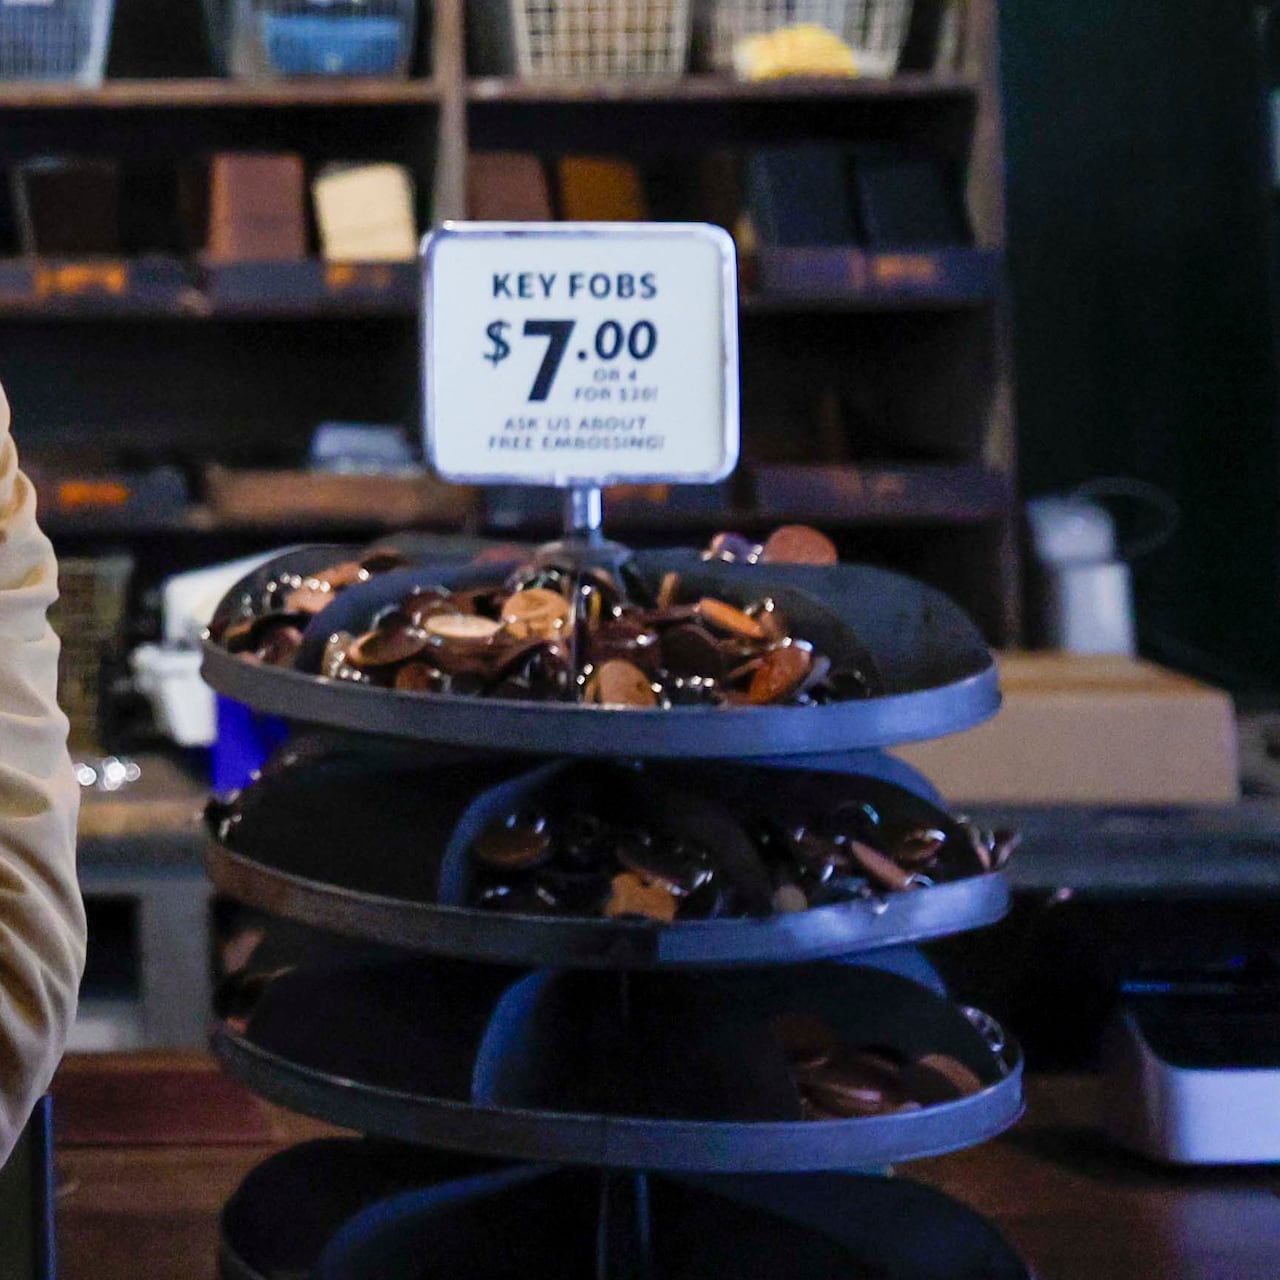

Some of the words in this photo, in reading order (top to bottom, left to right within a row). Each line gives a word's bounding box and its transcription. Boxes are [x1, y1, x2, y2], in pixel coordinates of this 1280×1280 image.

[492, 272, 557, 299] KEY
[569, 272, 658, 299] FOBS
[484, 319, 658, 402] $7.00
[593, 368, 620, 382] OR
[628, 368, 637, 382] 4
[575, 387, 611, 401] FOR
[505, 417, 537, 431] ASK
[548, 417, 570, 431] US
[580, 417, 647, 431] ABOUT
[488, 436, 532, 450] FREE
[542, 436, 665, 450] EMBOSSING!
